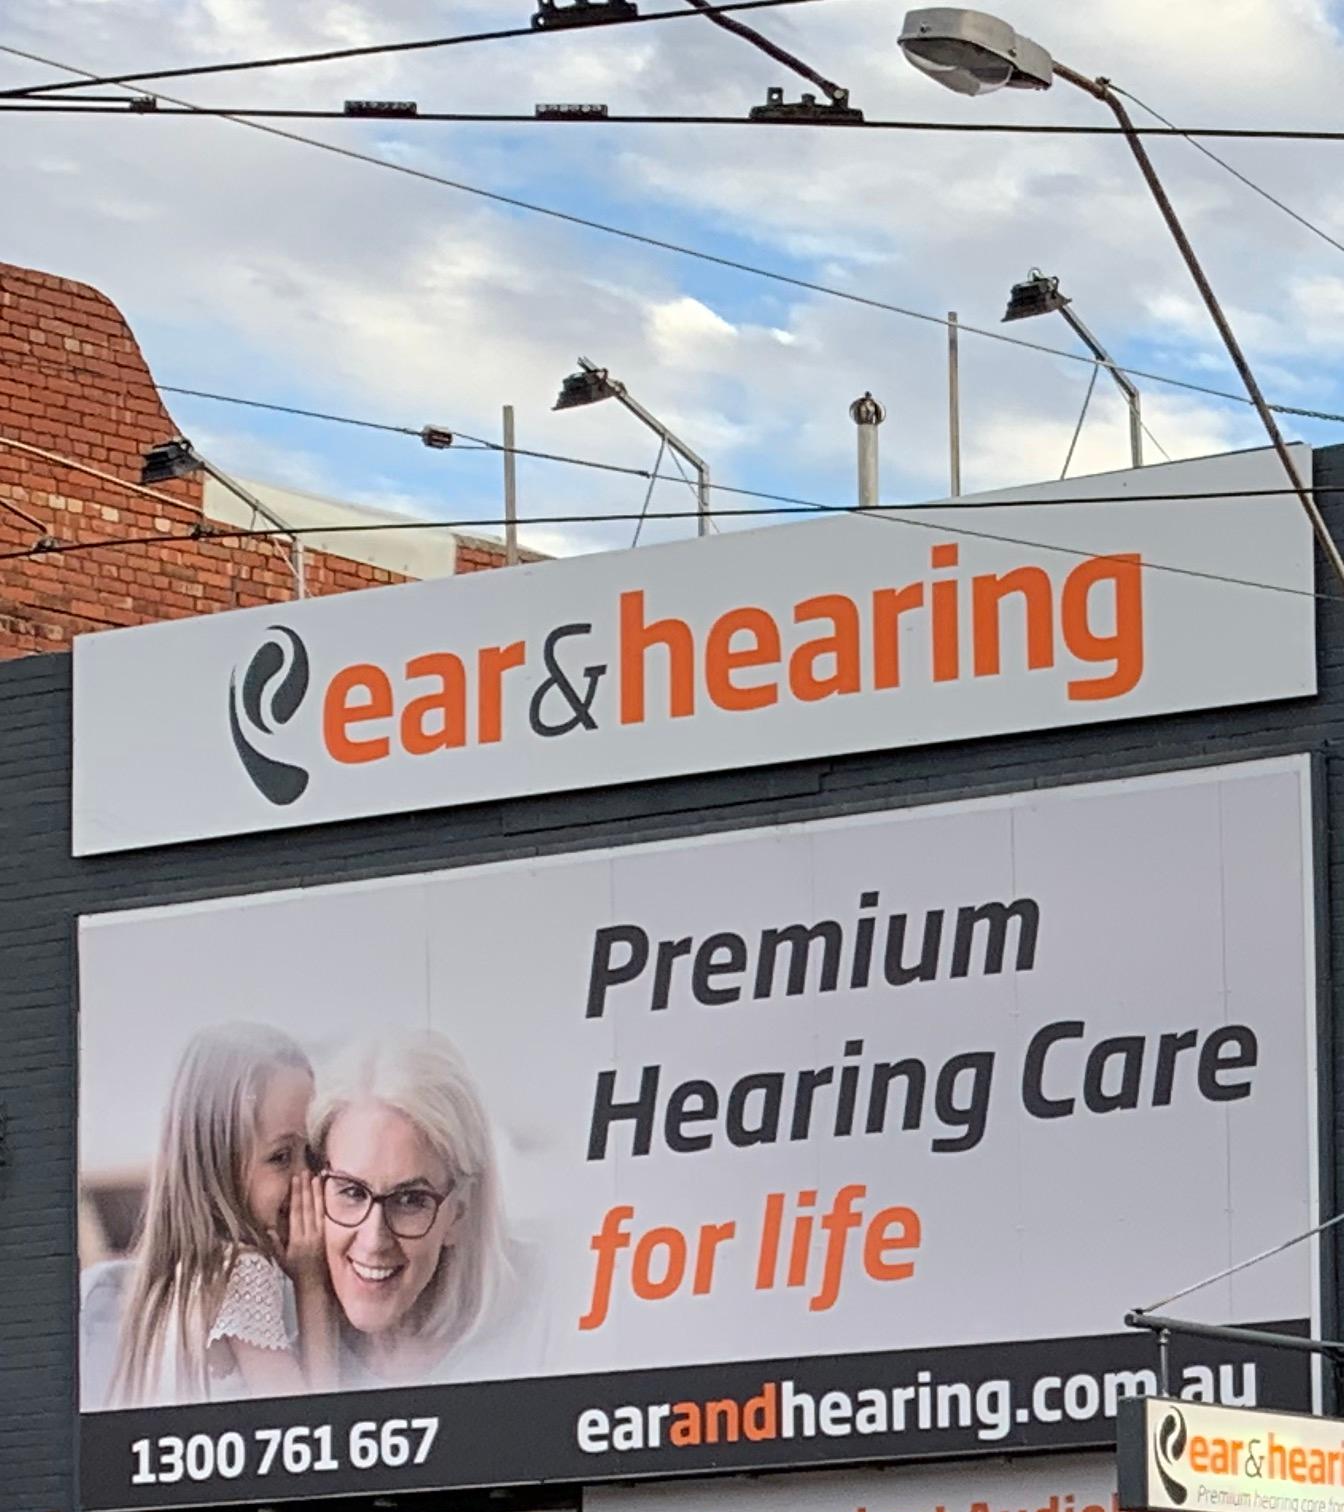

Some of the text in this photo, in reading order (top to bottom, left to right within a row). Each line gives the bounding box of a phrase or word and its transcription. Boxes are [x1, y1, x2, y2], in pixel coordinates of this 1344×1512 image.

[585, 890, 1041, 1019] Premium
[587, 1018, 1260, 1162] Hearing Care
[579, 1184, 923, 1331] for life
[131, 1417, 440, 1485] 1300 761 667
[576, 1362, 1258, 1453] earandhearing.comau
[1197, 1484, 1251, 1506] Premium
